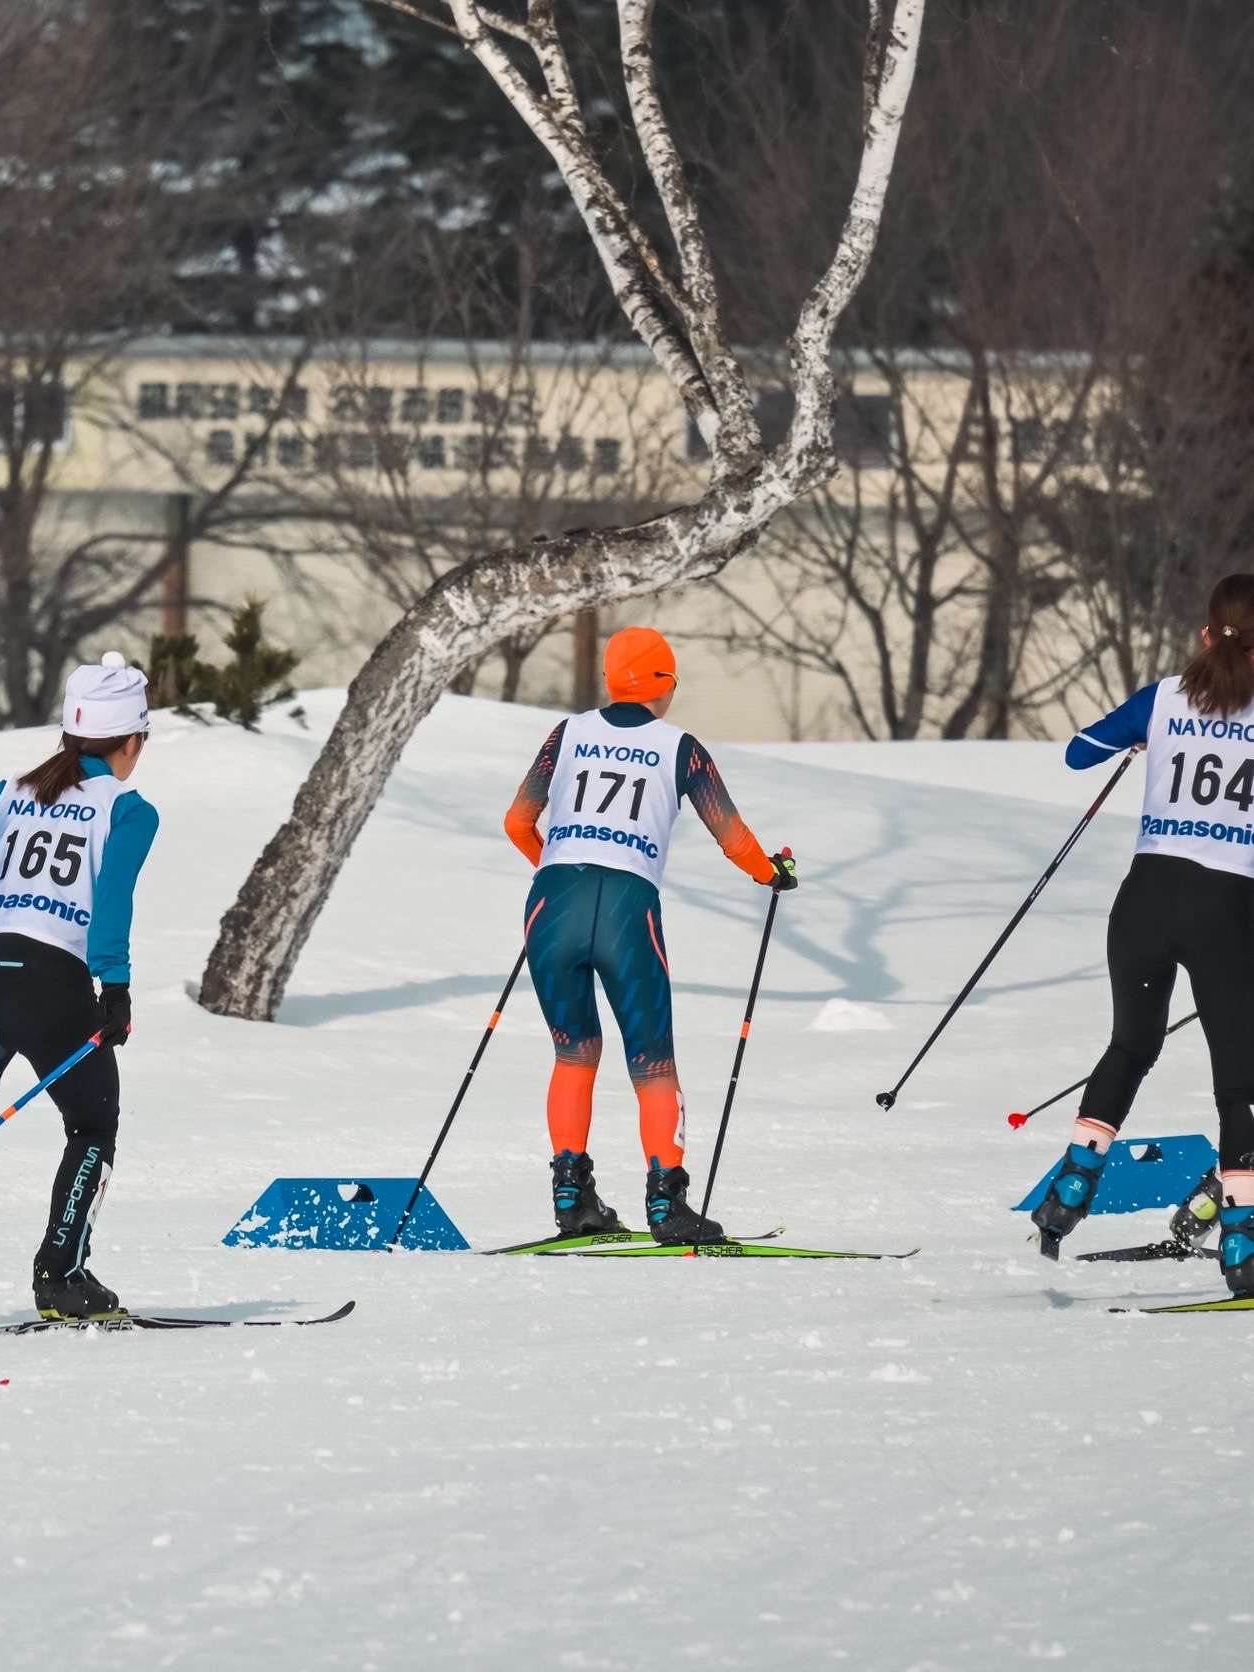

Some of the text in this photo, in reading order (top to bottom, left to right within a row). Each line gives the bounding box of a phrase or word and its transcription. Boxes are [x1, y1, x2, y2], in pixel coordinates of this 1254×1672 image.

[575, 743, 660, 767] NAYORO
[573, 769, 647, 821] 171
[1169, 752, 1254, 812] 164
[7, 799, 96, 822] NAYORO
[548, 823, 659, 859] Panasonic
[1141, 814, 1254, 845] Panasoni
[0, 829, 87, 886] 165
[63, 1146, 100, 1225] SPORTIVA
[591, 1233, 633, 1245] FISCHER
